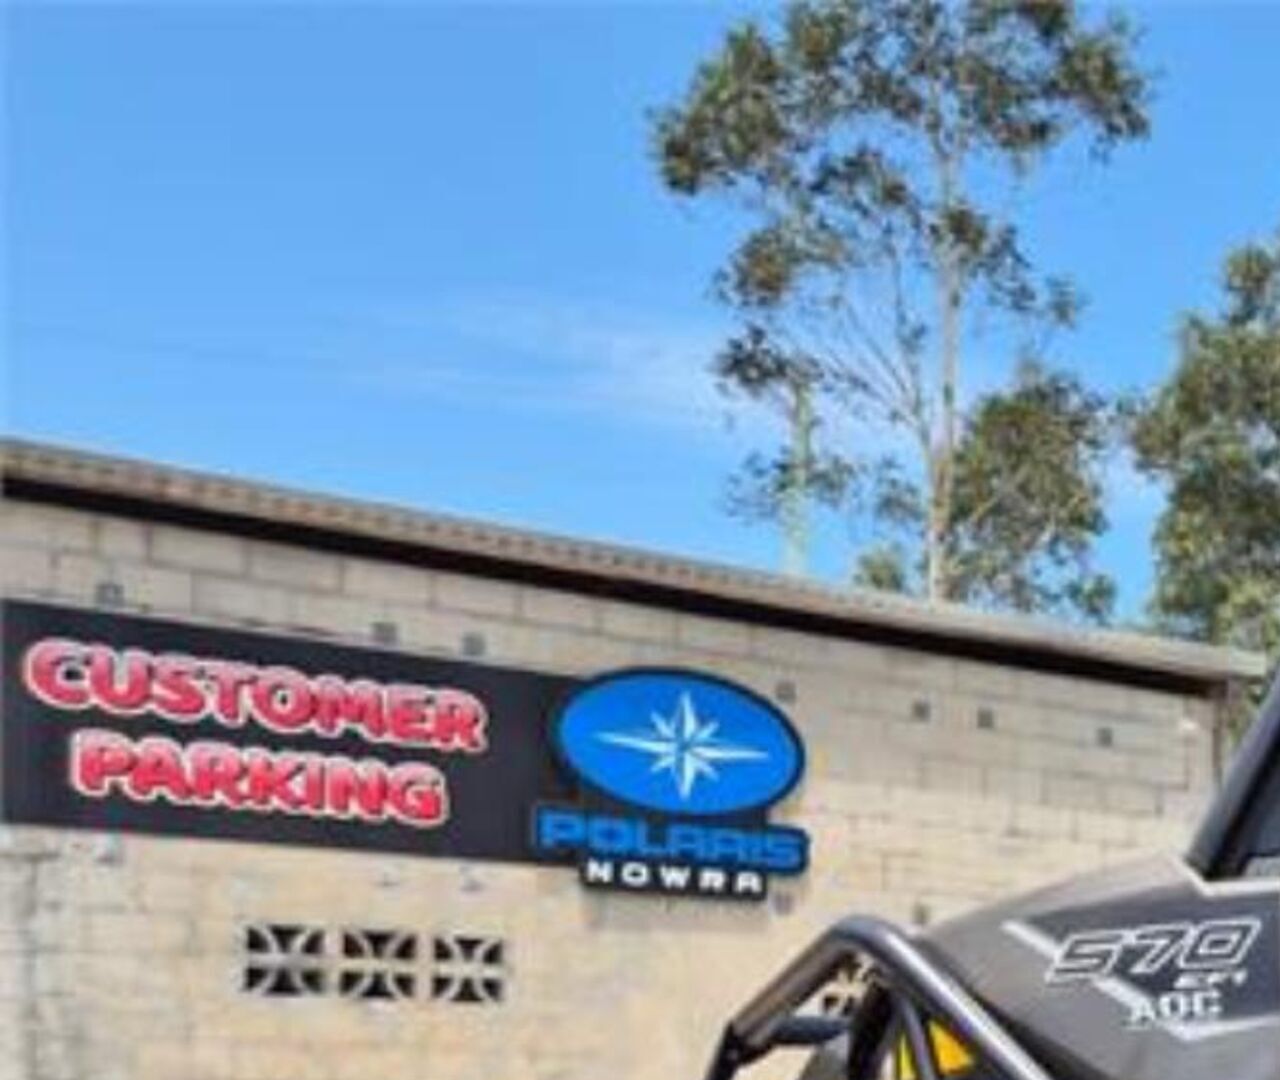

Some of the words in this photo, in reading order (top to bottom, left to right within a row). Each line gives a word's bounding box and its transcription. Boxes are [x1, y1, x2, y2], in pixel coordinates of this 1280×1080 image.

[22, 640, 488, 752] CUSTOMER
[69, 730, 447, 827] PARKING
[538, 808, 806, 870] POLARIS
[585, 857, 762, 893] NOWRA
[1045, 916, 1262, 983] 570
